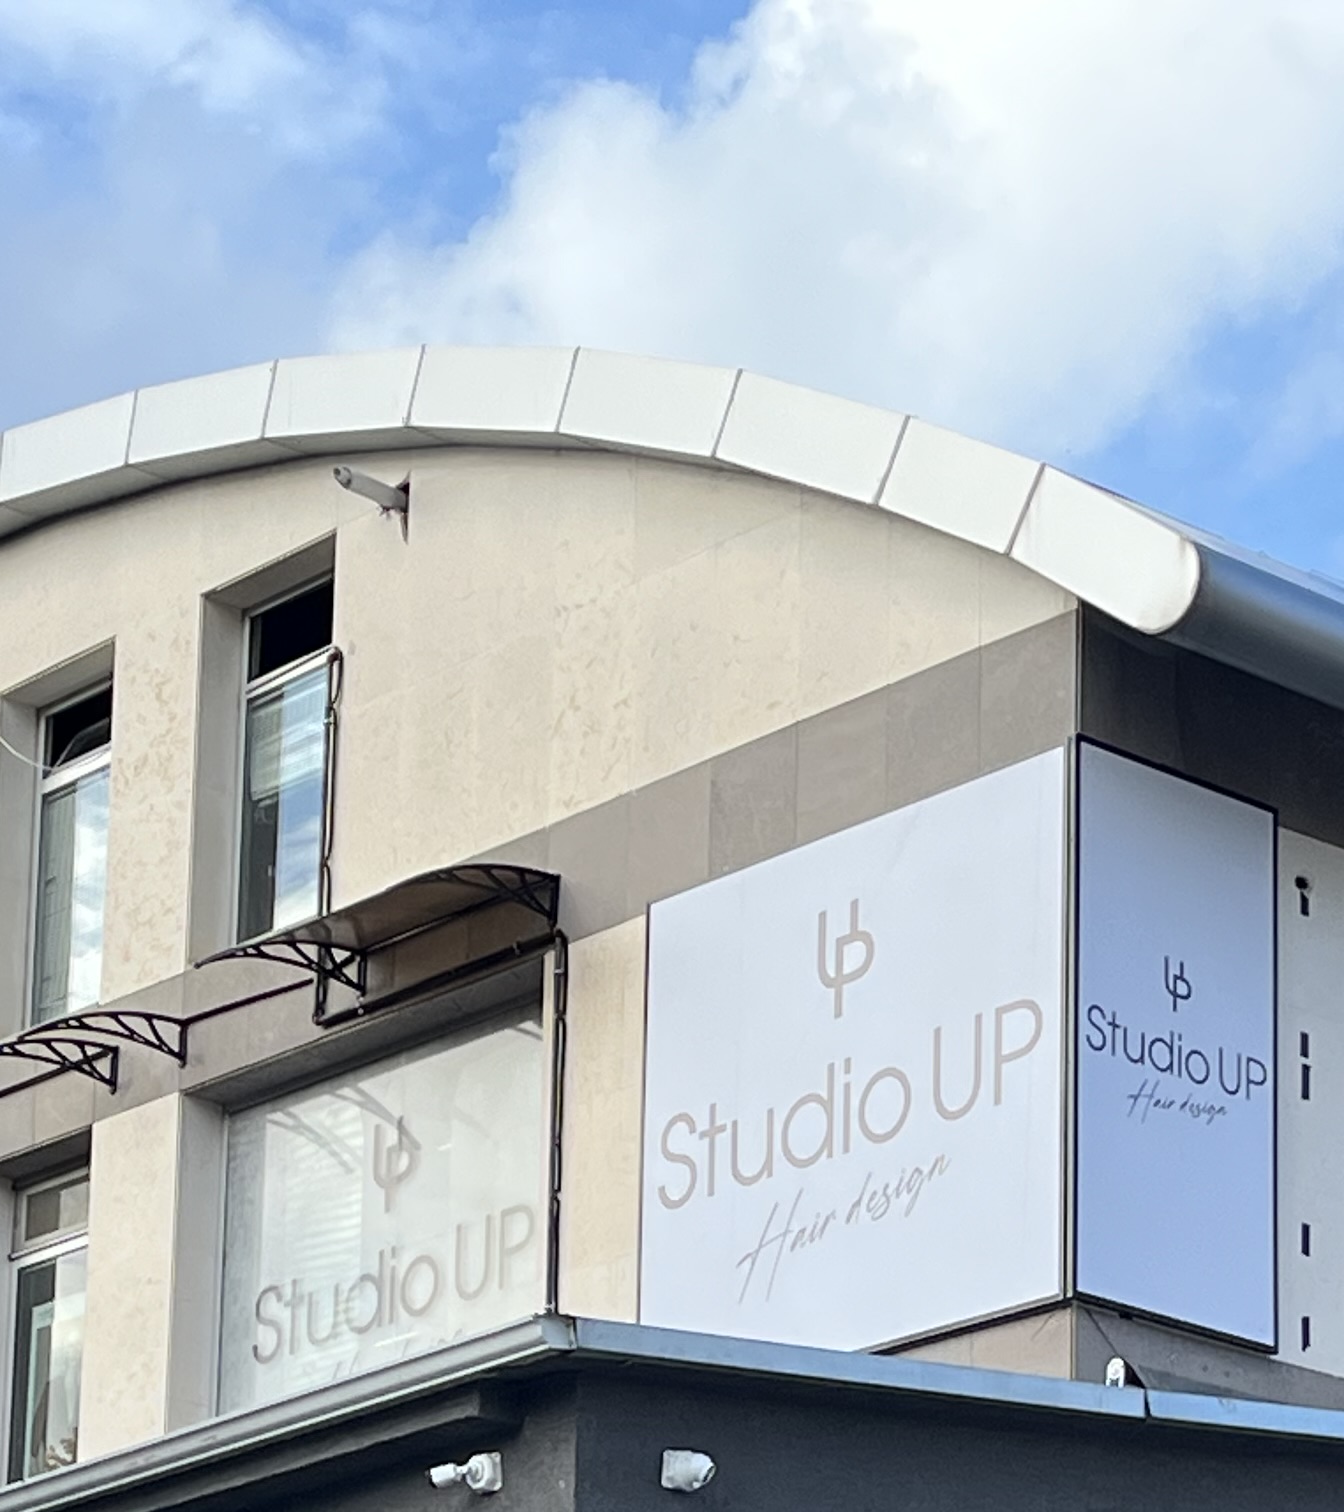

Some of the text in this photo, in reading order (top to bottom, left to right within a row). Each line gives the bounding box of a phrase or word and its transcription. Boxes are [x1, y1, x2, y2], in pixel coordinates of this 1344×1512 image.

[657, 998, 1044, 1211] Studio UP
[1085, 1004, 1268, 1100] Studio UP
[1127, 1078, 1228, 1126] Hair design
[252, 1245, 440, 1365] Studio
[456, 1203, 536, 1301] UP
[735, 1153, 952, 1306] Hair design
